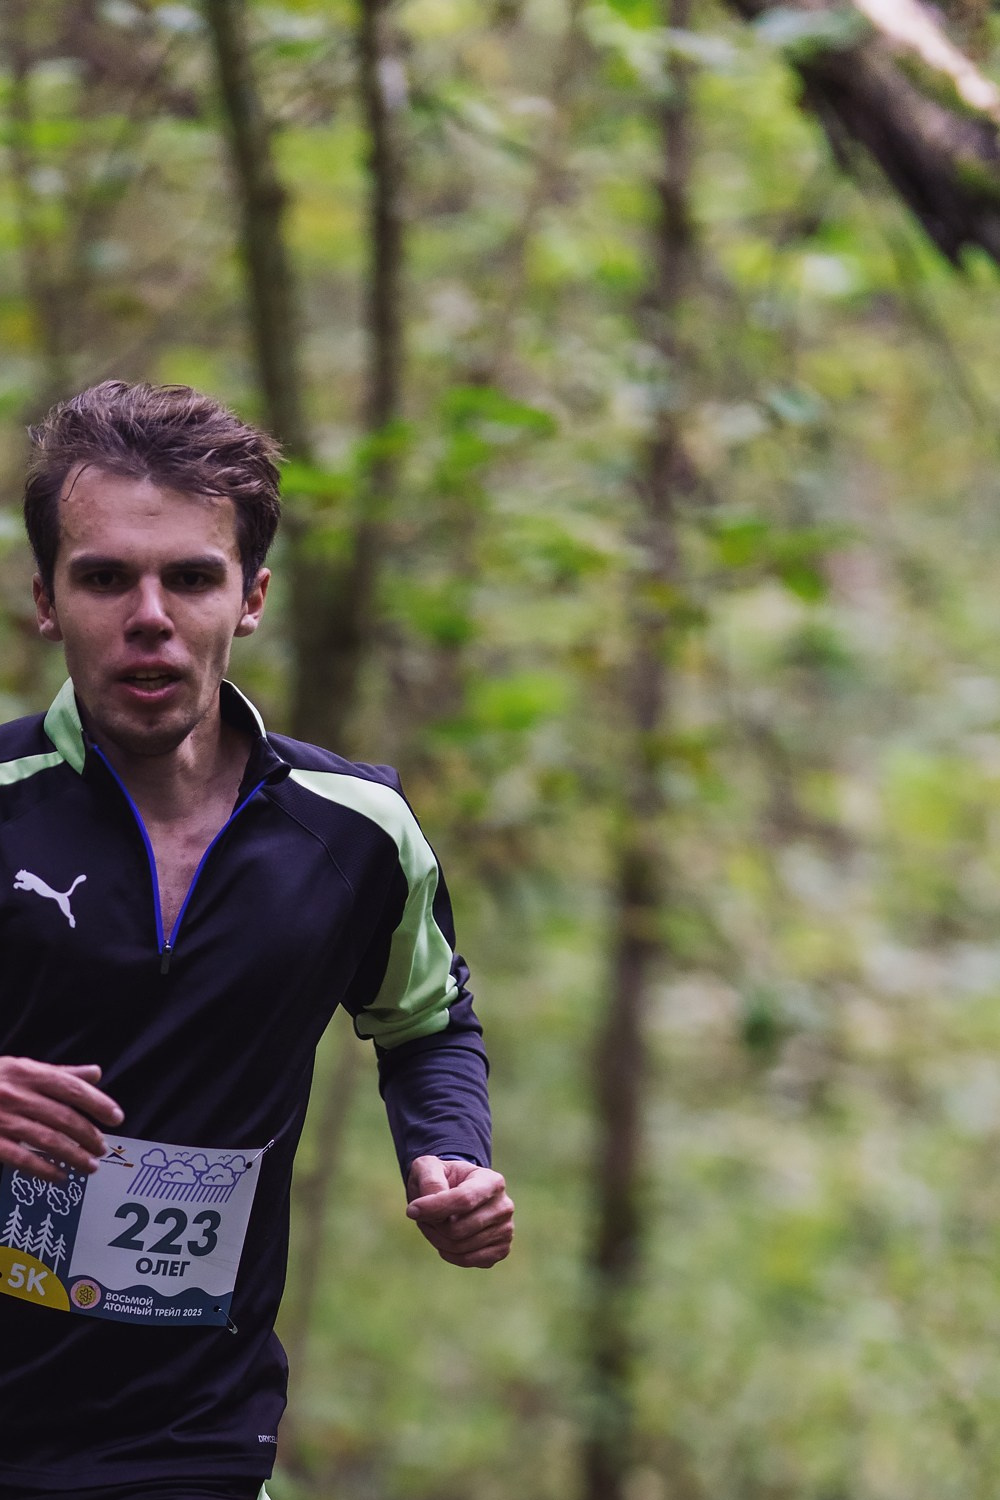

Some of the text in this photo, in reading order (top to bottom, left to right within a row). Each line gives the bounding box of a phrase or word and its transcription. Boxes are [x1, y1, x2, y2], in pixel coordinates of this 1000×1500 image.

[107, 1202, 222, 1257] 223
[135, 1257, 191, 1277] ОЛЕГ
[105, 1292, 154, 1307] ВОСЬМОЙ
[103, 1302, 203, 1317] АТОМНЫЙ ТРЕЙЛ 2025
